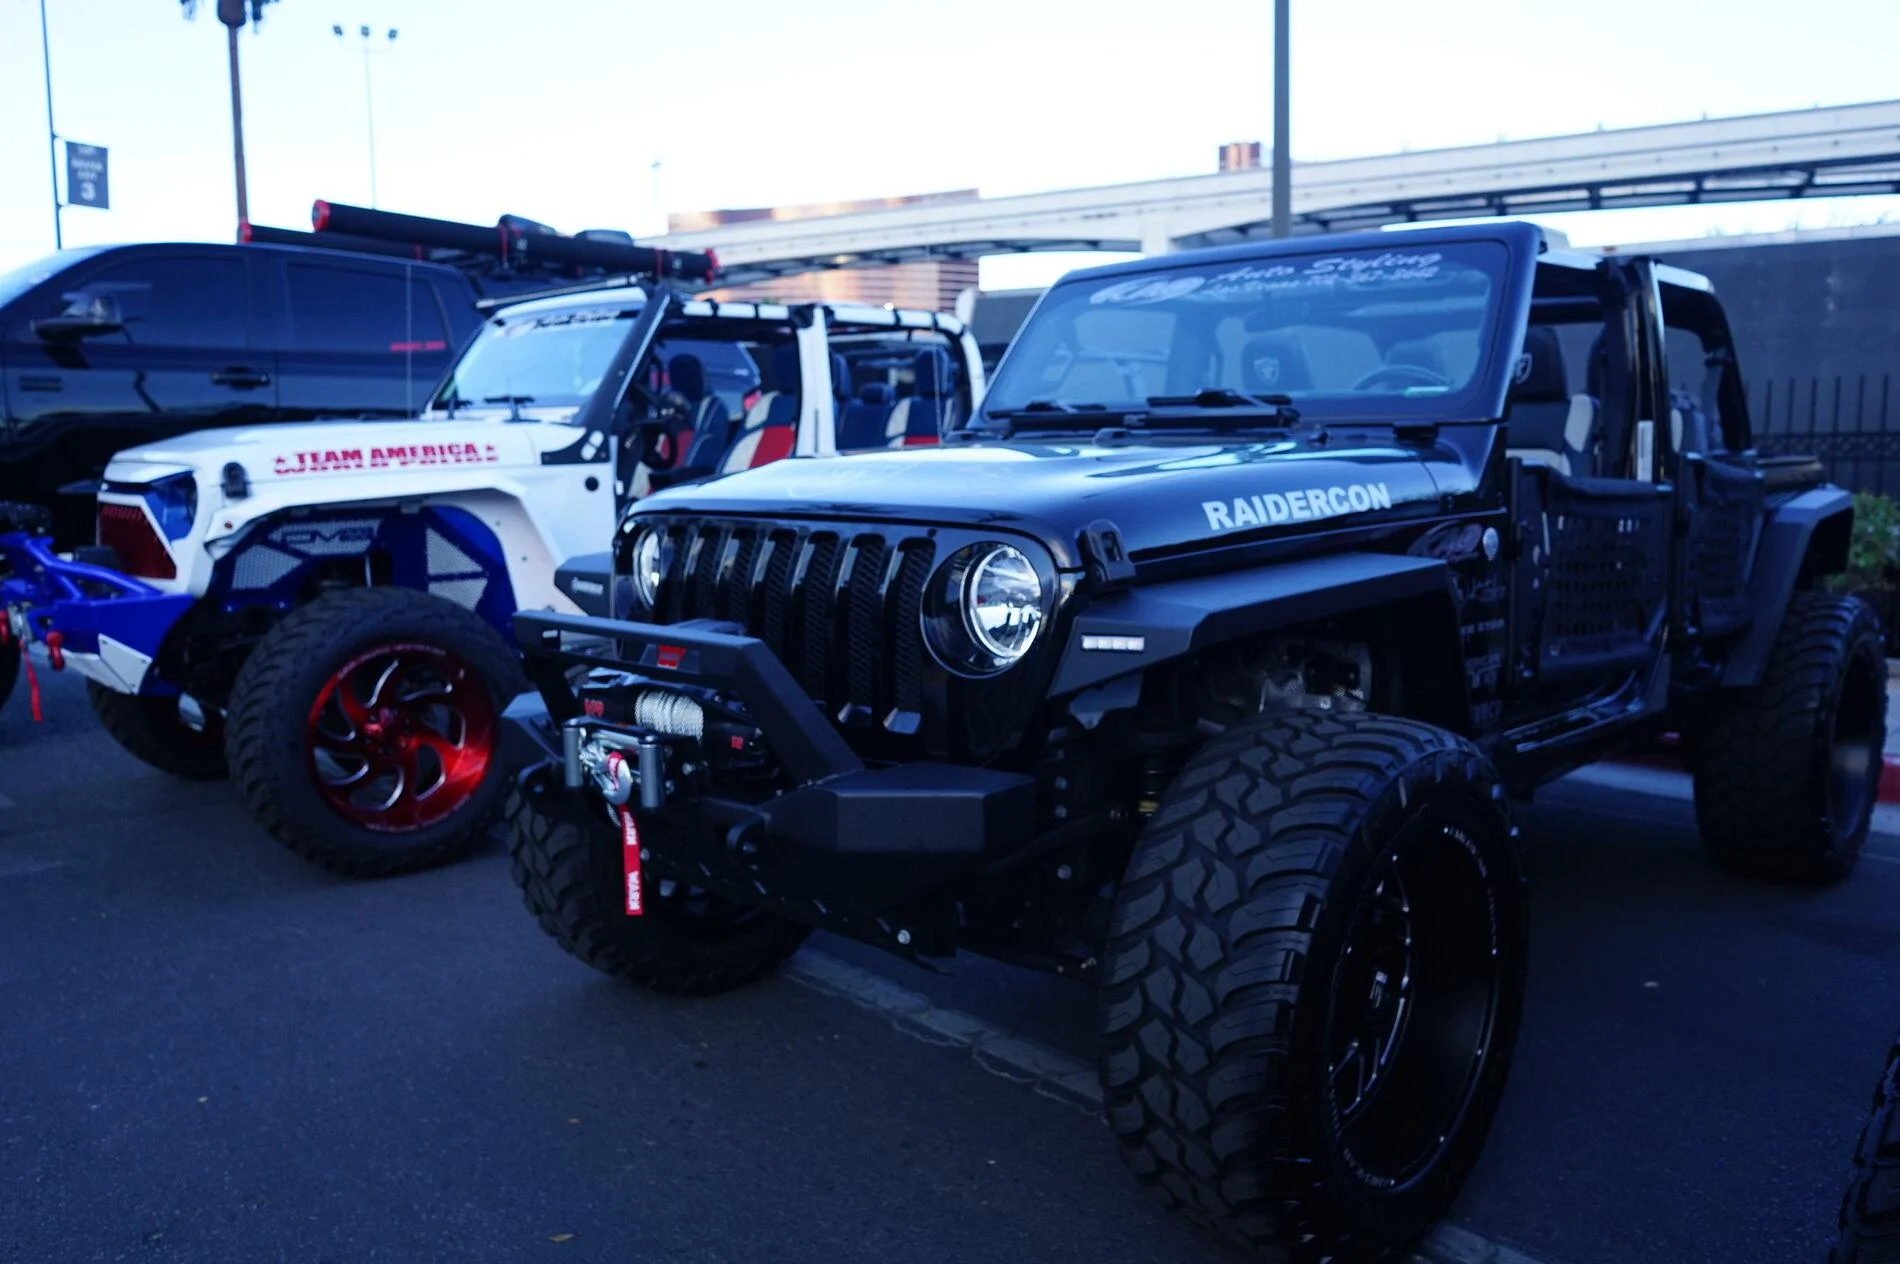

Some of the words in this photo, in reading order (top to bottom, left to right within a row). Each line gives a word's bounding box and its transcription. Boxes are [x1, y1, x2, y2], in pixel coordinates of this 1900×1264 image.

[80, 181, 96, 201] 3
[293, 447, 364, 472] TEAM
[369, 443, 483, 467] AMERICA
[1201, 482, 1392, 531] RAIDERCON
[628, 870, 641, 910] WARN
